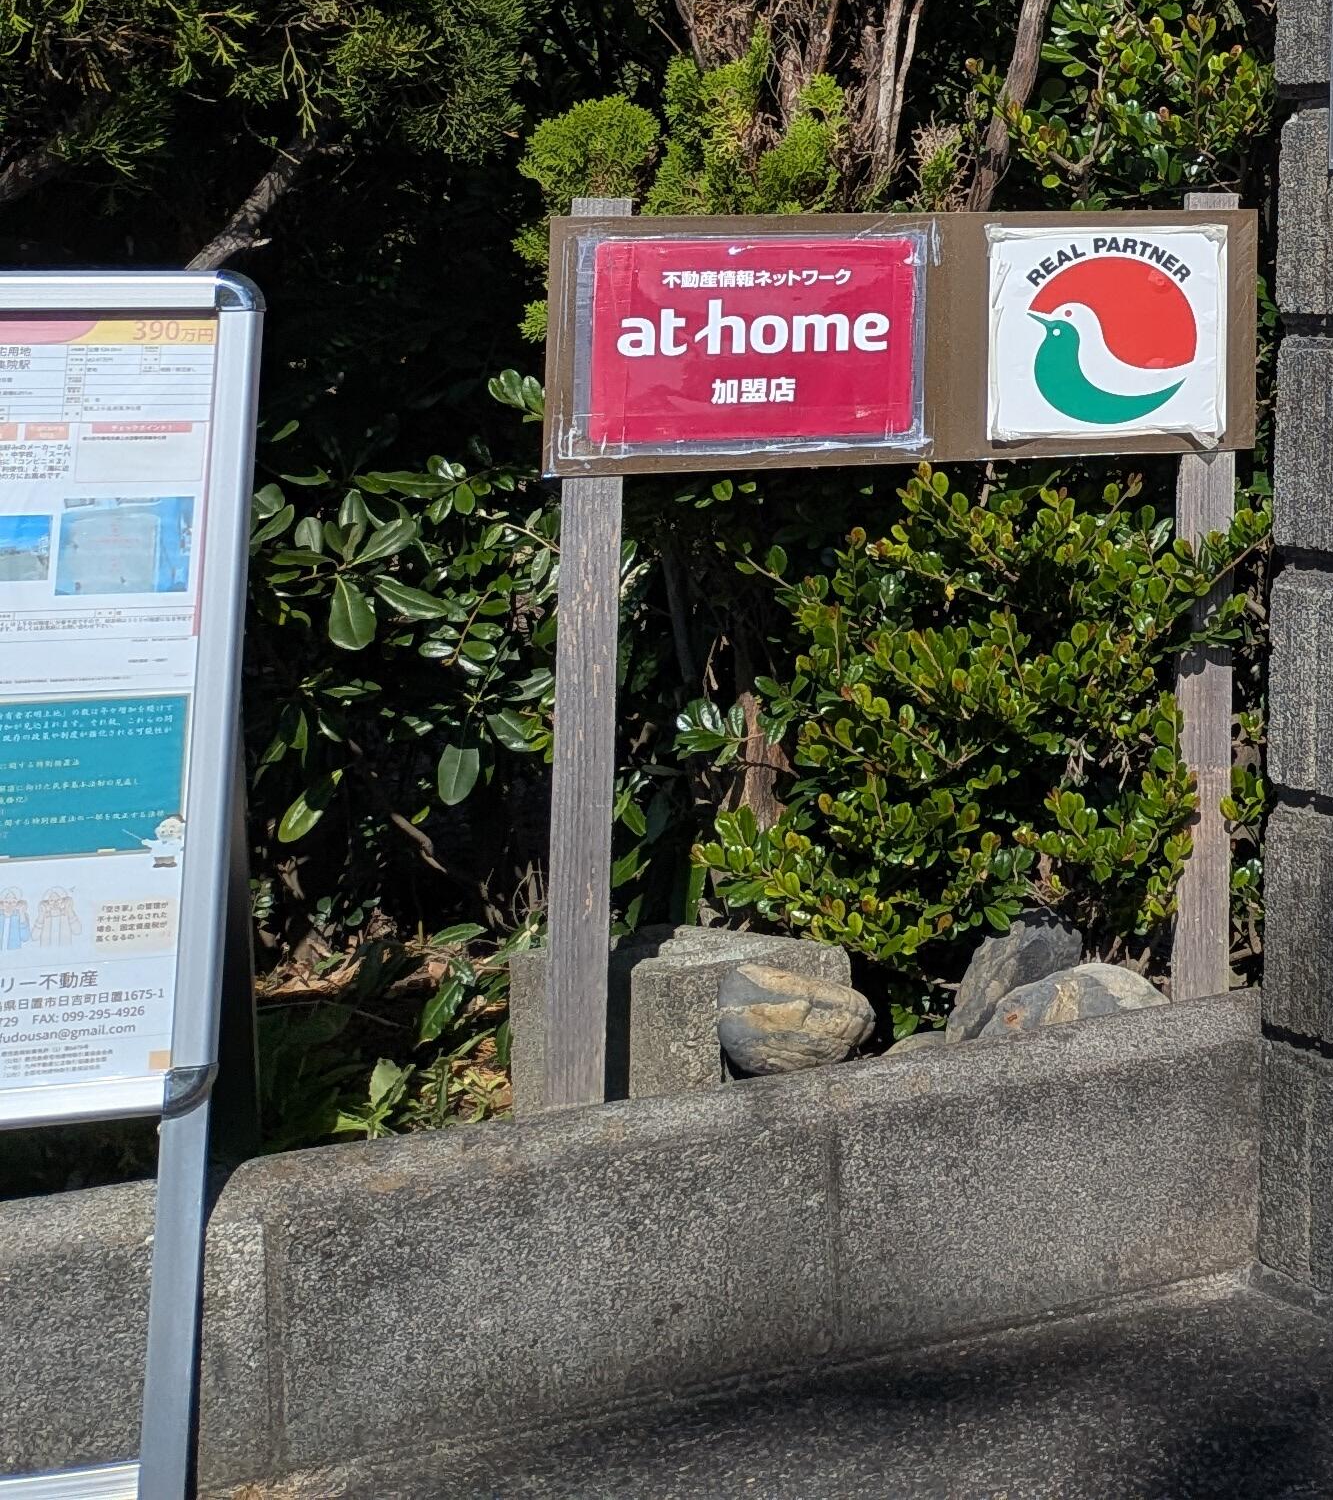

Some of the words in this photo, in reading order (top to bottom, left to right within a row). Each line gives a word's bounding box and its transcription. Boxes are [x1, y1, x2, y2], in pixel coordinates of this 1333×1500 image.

[1026, 244, 1086, 287] REAL
[1093, 237, 1192, 283] PARTNER
[662, 269, 851, 288] 不動産情報ネットワーク
[132, 320, 214, 342] 390万円
[617, 308, 688, 357] at
[694, 299, 890, 355] home
[711, 377, 796, 404] 加盟店
[1, 970, 98, 993] リー不動産
[0, 988, 164, 1012] 県日置市日吉町日置1675-1
[32, 1013, 59, 1024] FAX:
[62, 1006, 145, 1022] 099-295-4926
